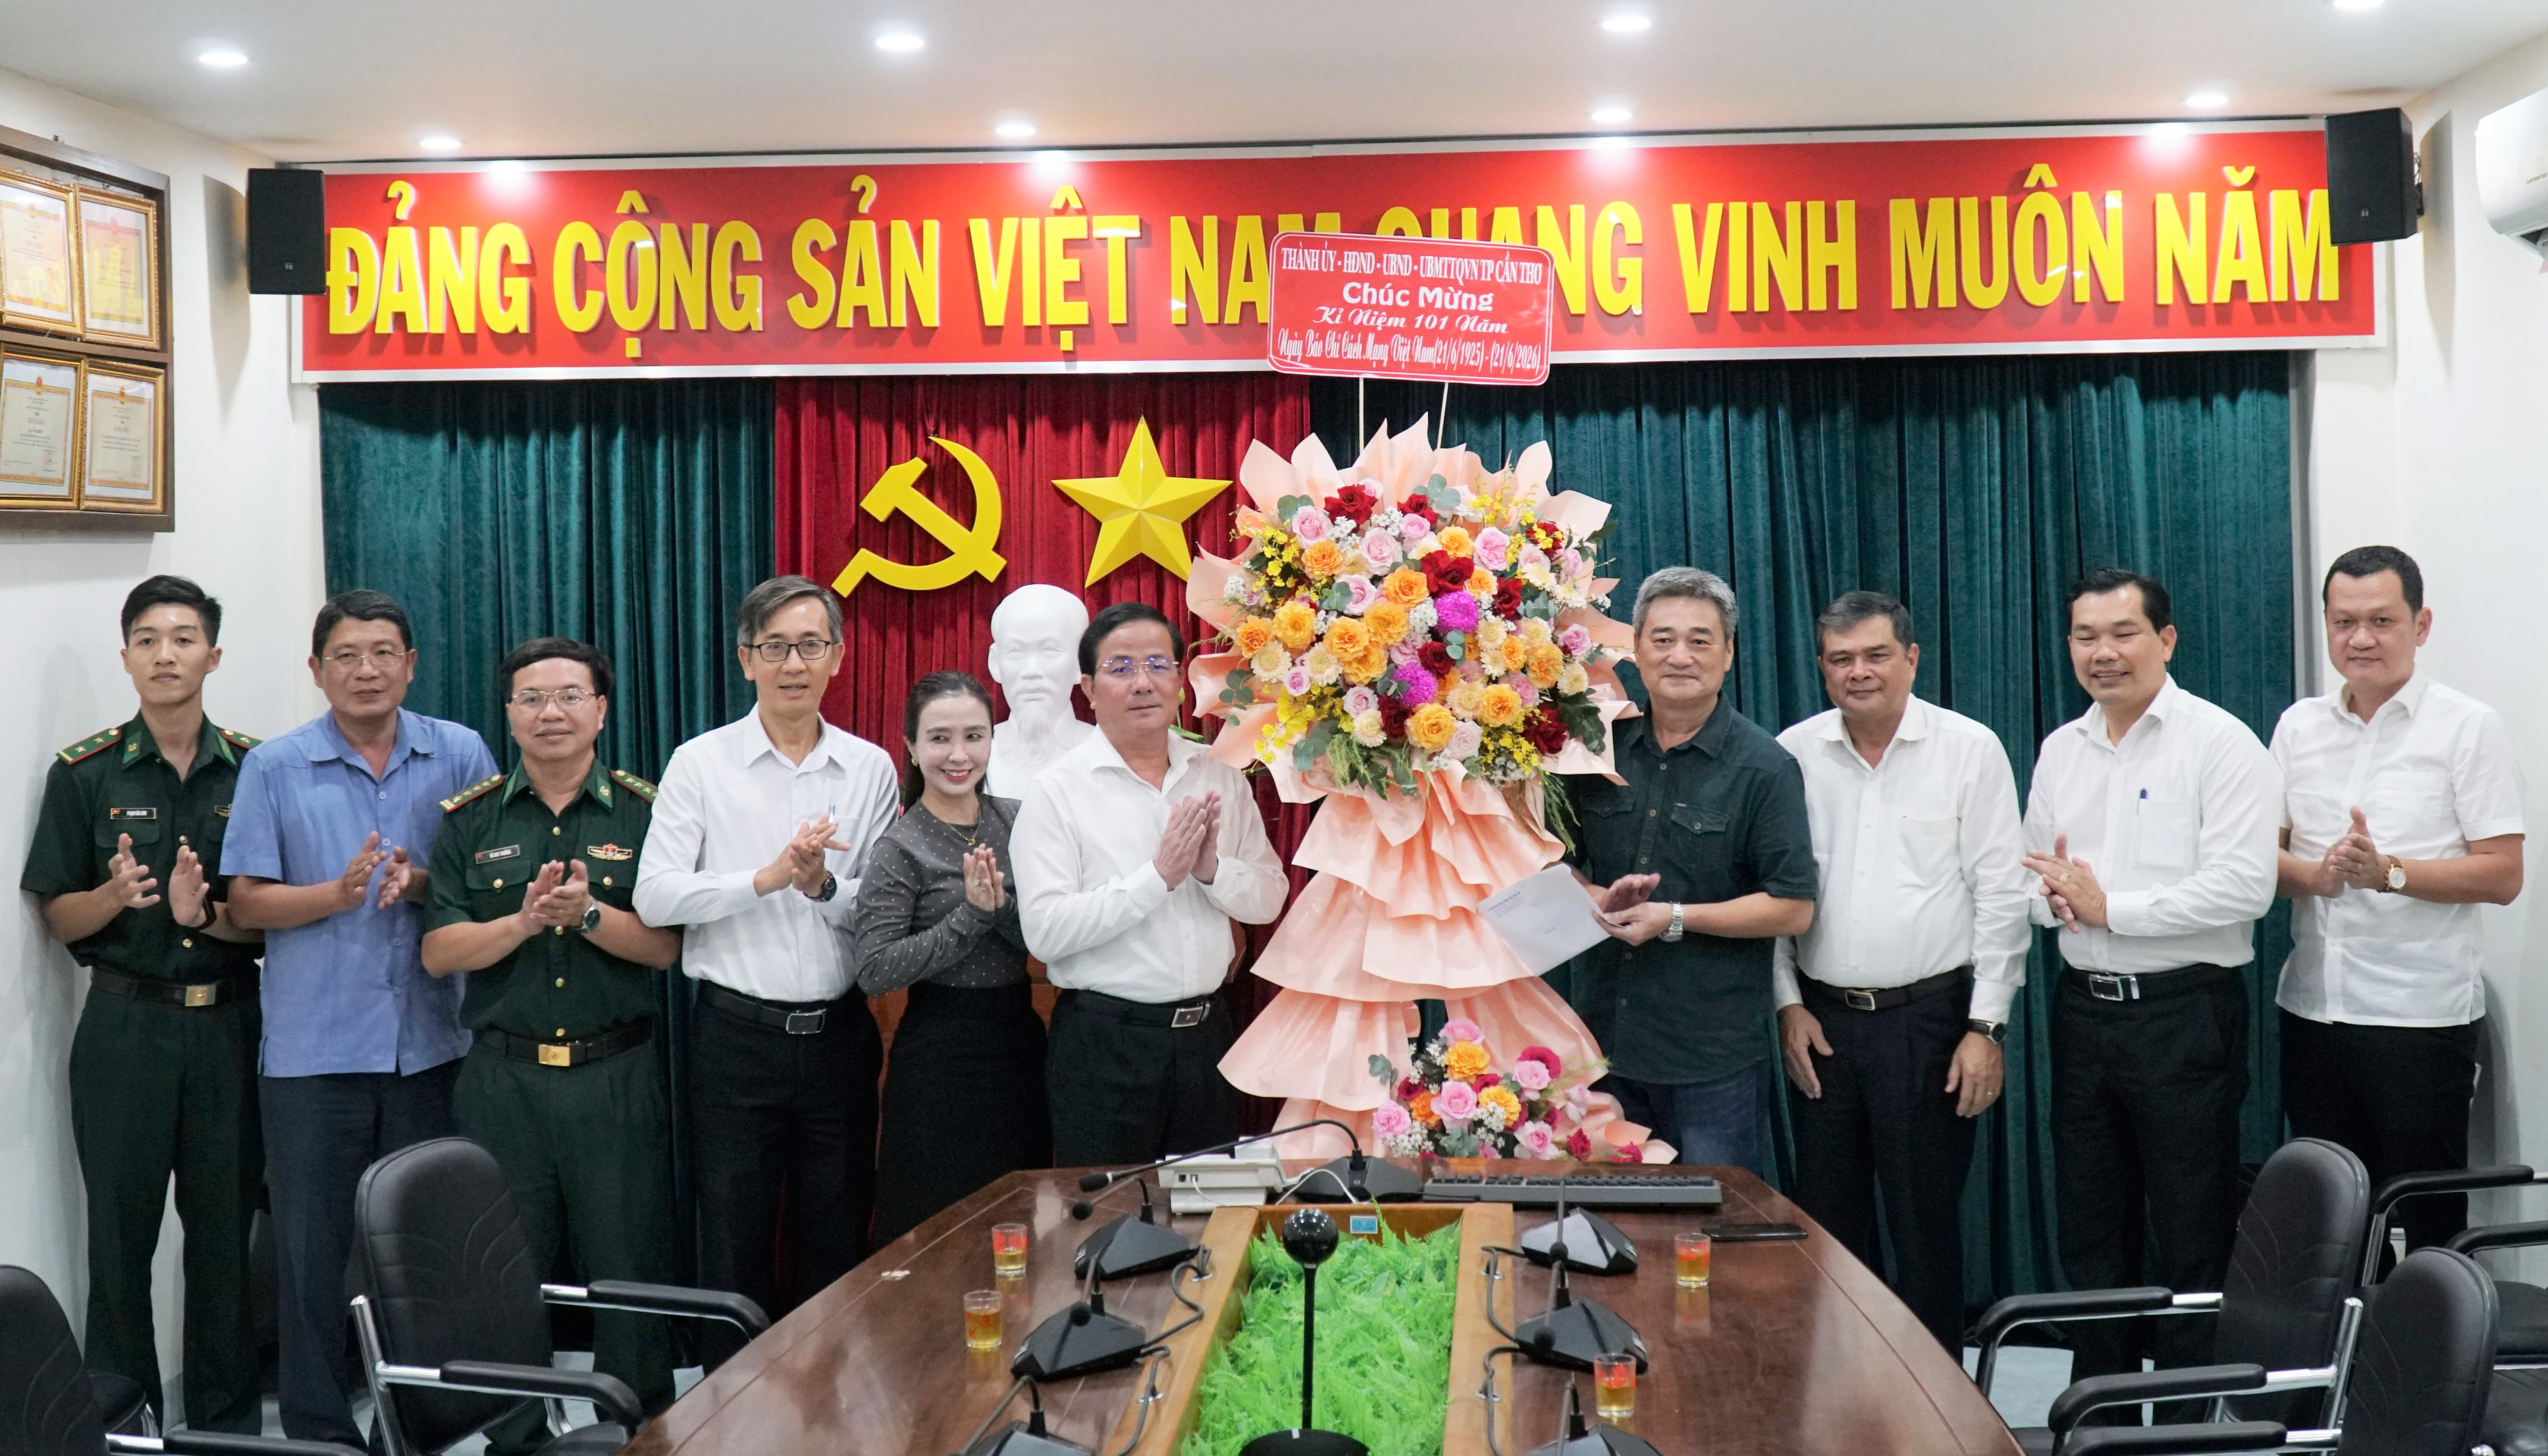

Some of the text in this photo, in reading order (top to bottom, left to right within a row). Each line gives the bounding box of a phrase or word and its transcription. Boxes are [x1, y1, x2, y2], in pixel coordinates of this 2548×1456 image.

[326, 180, 531, 334] ĐẢNG
[553, 190, 762, 358] CỘNG
[787, 174, 940, 330] SẢN
[969, 184, 1141, 351] VIỆT
[1170, 212, 1340, 325] NA
[1672, 199, 1857, 314] VINH
[1889, 163, 2124, 310] MUÔN
[2155, 165, 2340, 305] NĂM
[1281, 241, 1319, 271] THÀNH
[1343, 251, 1375, 274] HĐND
[1383, 253, 1412, 276] UBND
[1420, 256, 1478, 286] UBMTTQVN
[1480, 259, 1494, 281] TP
[1495, 251, 1518, 283] CẦN
[1519, 262, 1543, 285] THƠ
[1312, 306, 1508, 333] Kỉ Niệm 101 Năm
[1343, 282, 1494, 312] Chúc Mừng
[1278, 328, 1303, 362] Ngày
[1305, 329, 1323, 357] Báo
[1325, 330, 1341, 358] Chí
[1342, 331, 1362, 359] Cách
[1362, 332, 1389, 368] Mạng
[1391, 334, 1411, 369] Việt
[1490, 340, 1541, 375] (21/6/2026)
